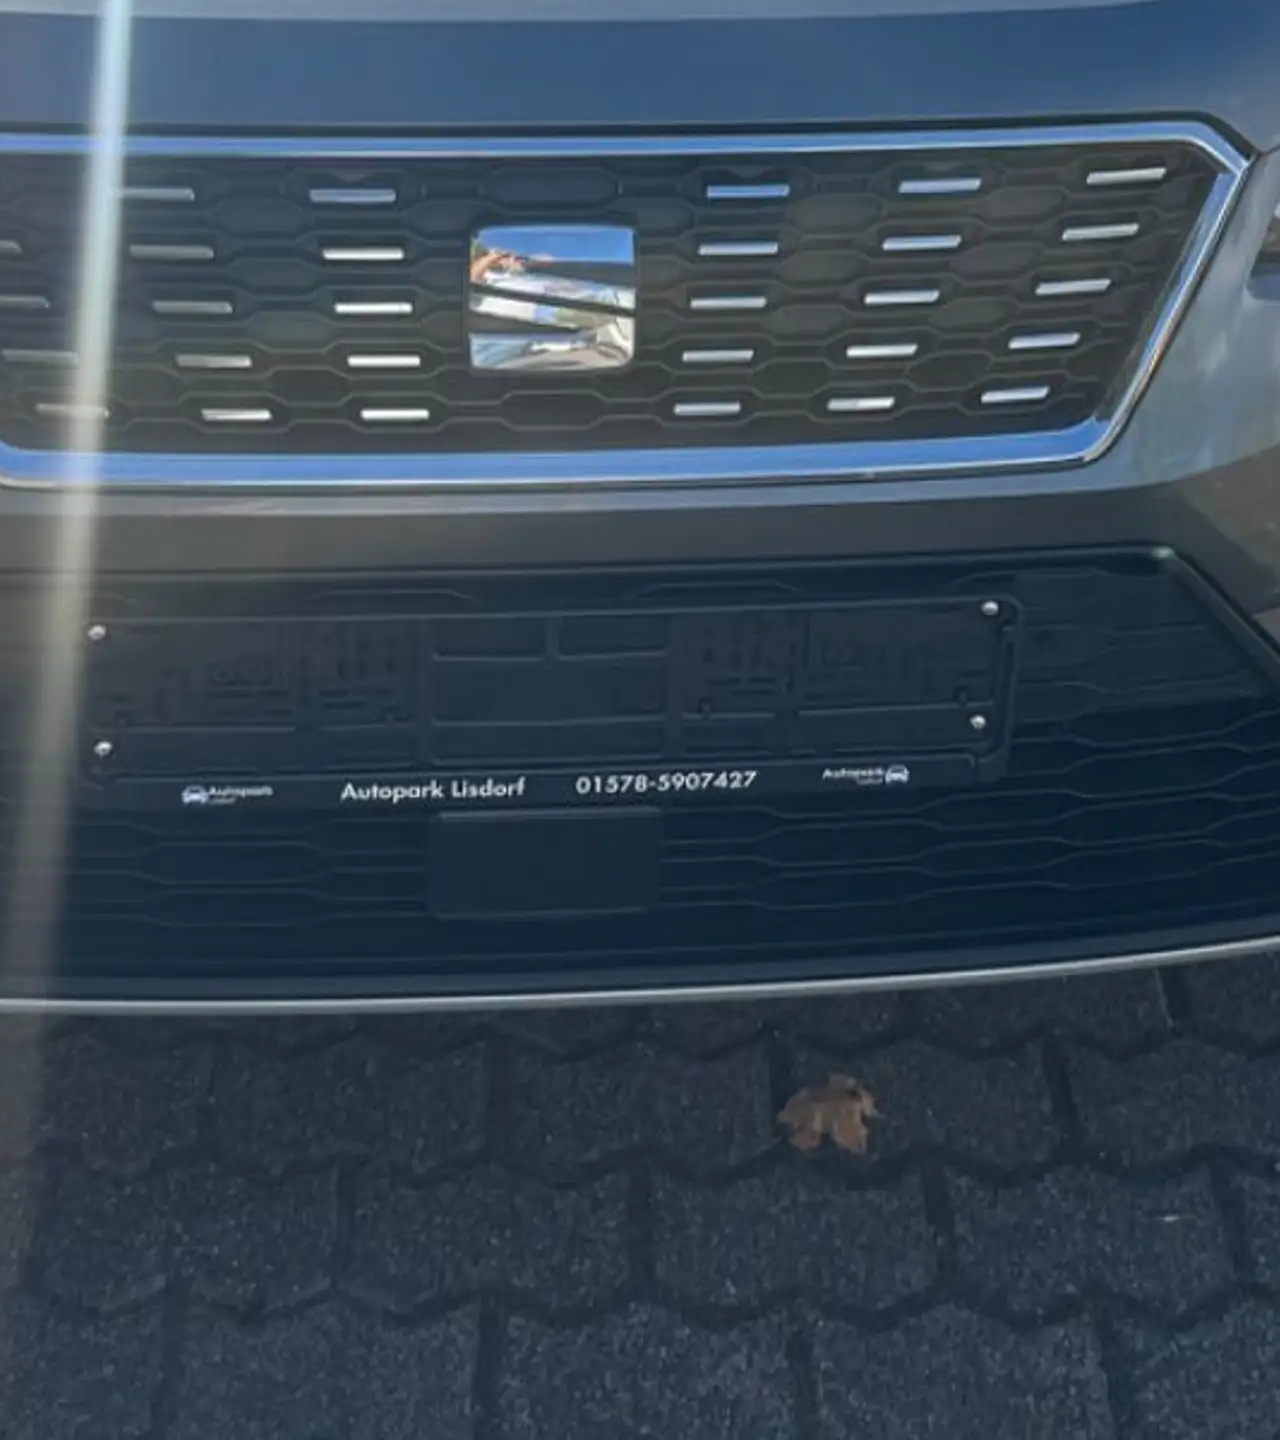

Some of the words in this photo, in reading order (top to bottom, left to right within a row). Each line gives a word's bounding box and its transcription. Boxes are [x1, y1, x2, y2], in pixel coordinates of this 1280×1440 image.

[340, 780, 445, 805] Autopark
[451, 776, 526, 798] Lisdorf
[575, 771, 757, 794] 01578-5907427
